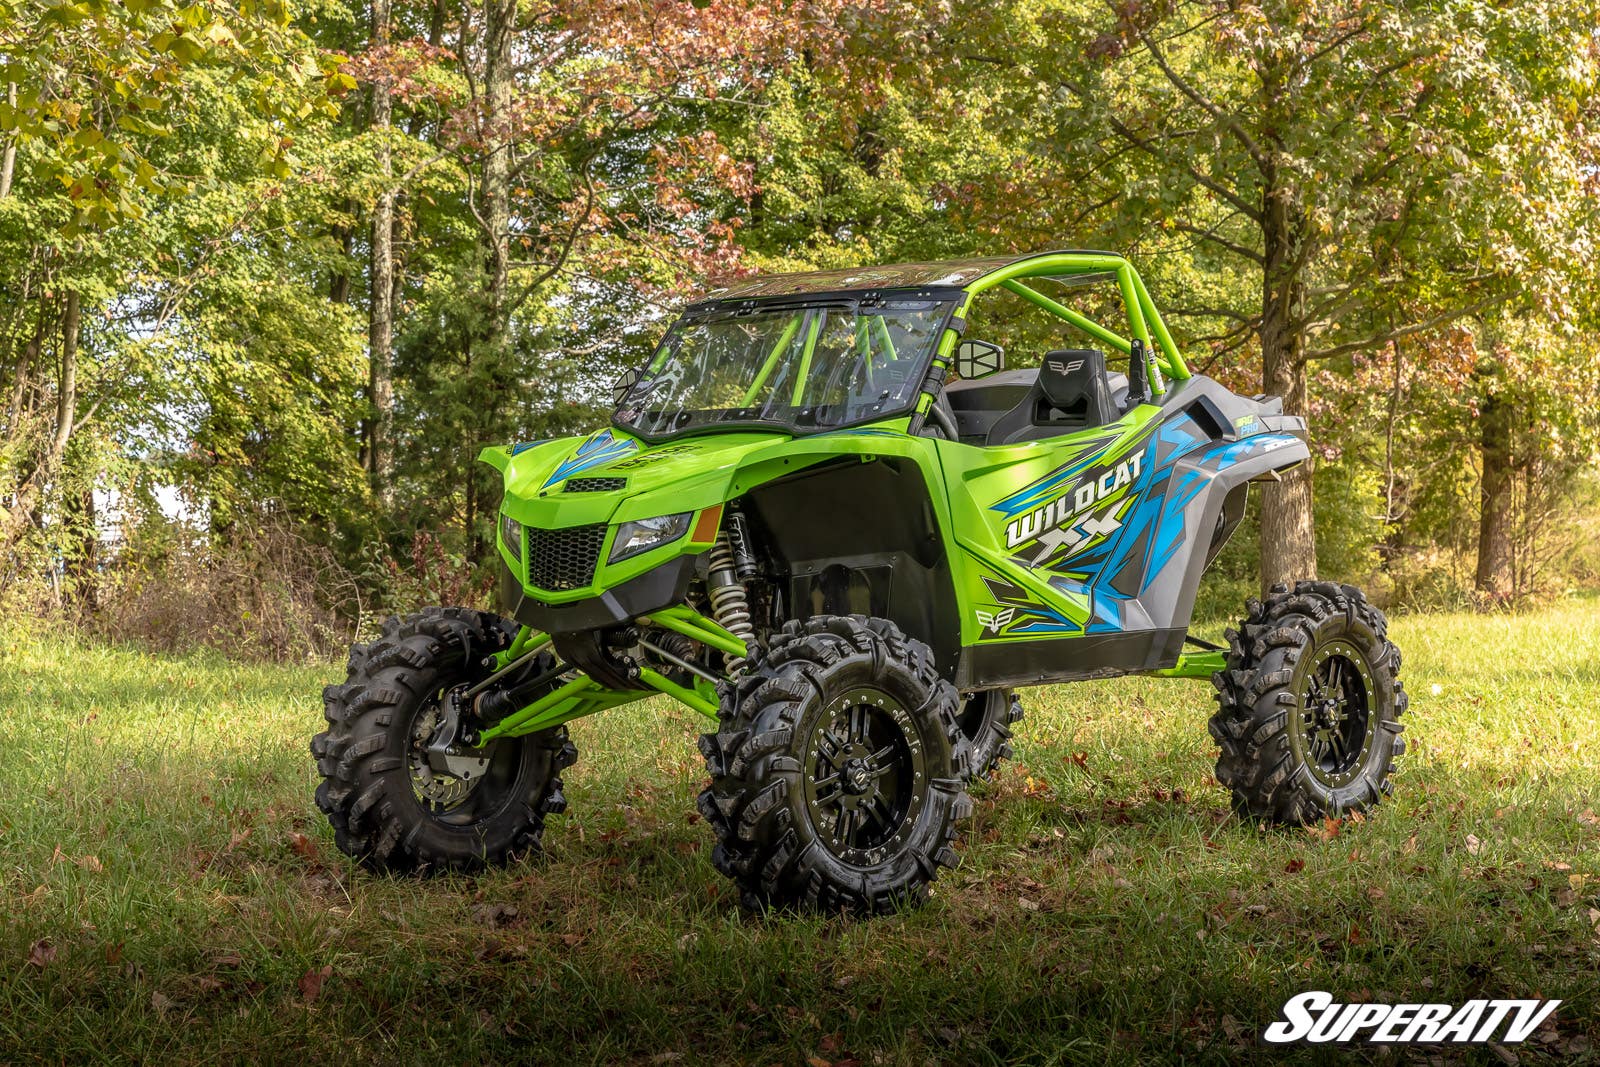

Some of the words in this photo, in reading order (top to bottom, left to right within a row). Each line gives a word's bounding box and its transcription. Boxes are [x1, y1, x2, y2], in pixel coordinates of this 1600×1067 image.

[1240, 422, 1259, 436] PRO
[1006, 448, 1145, 549] WILDCAT
[1030, 496, 1131, 568] XX
